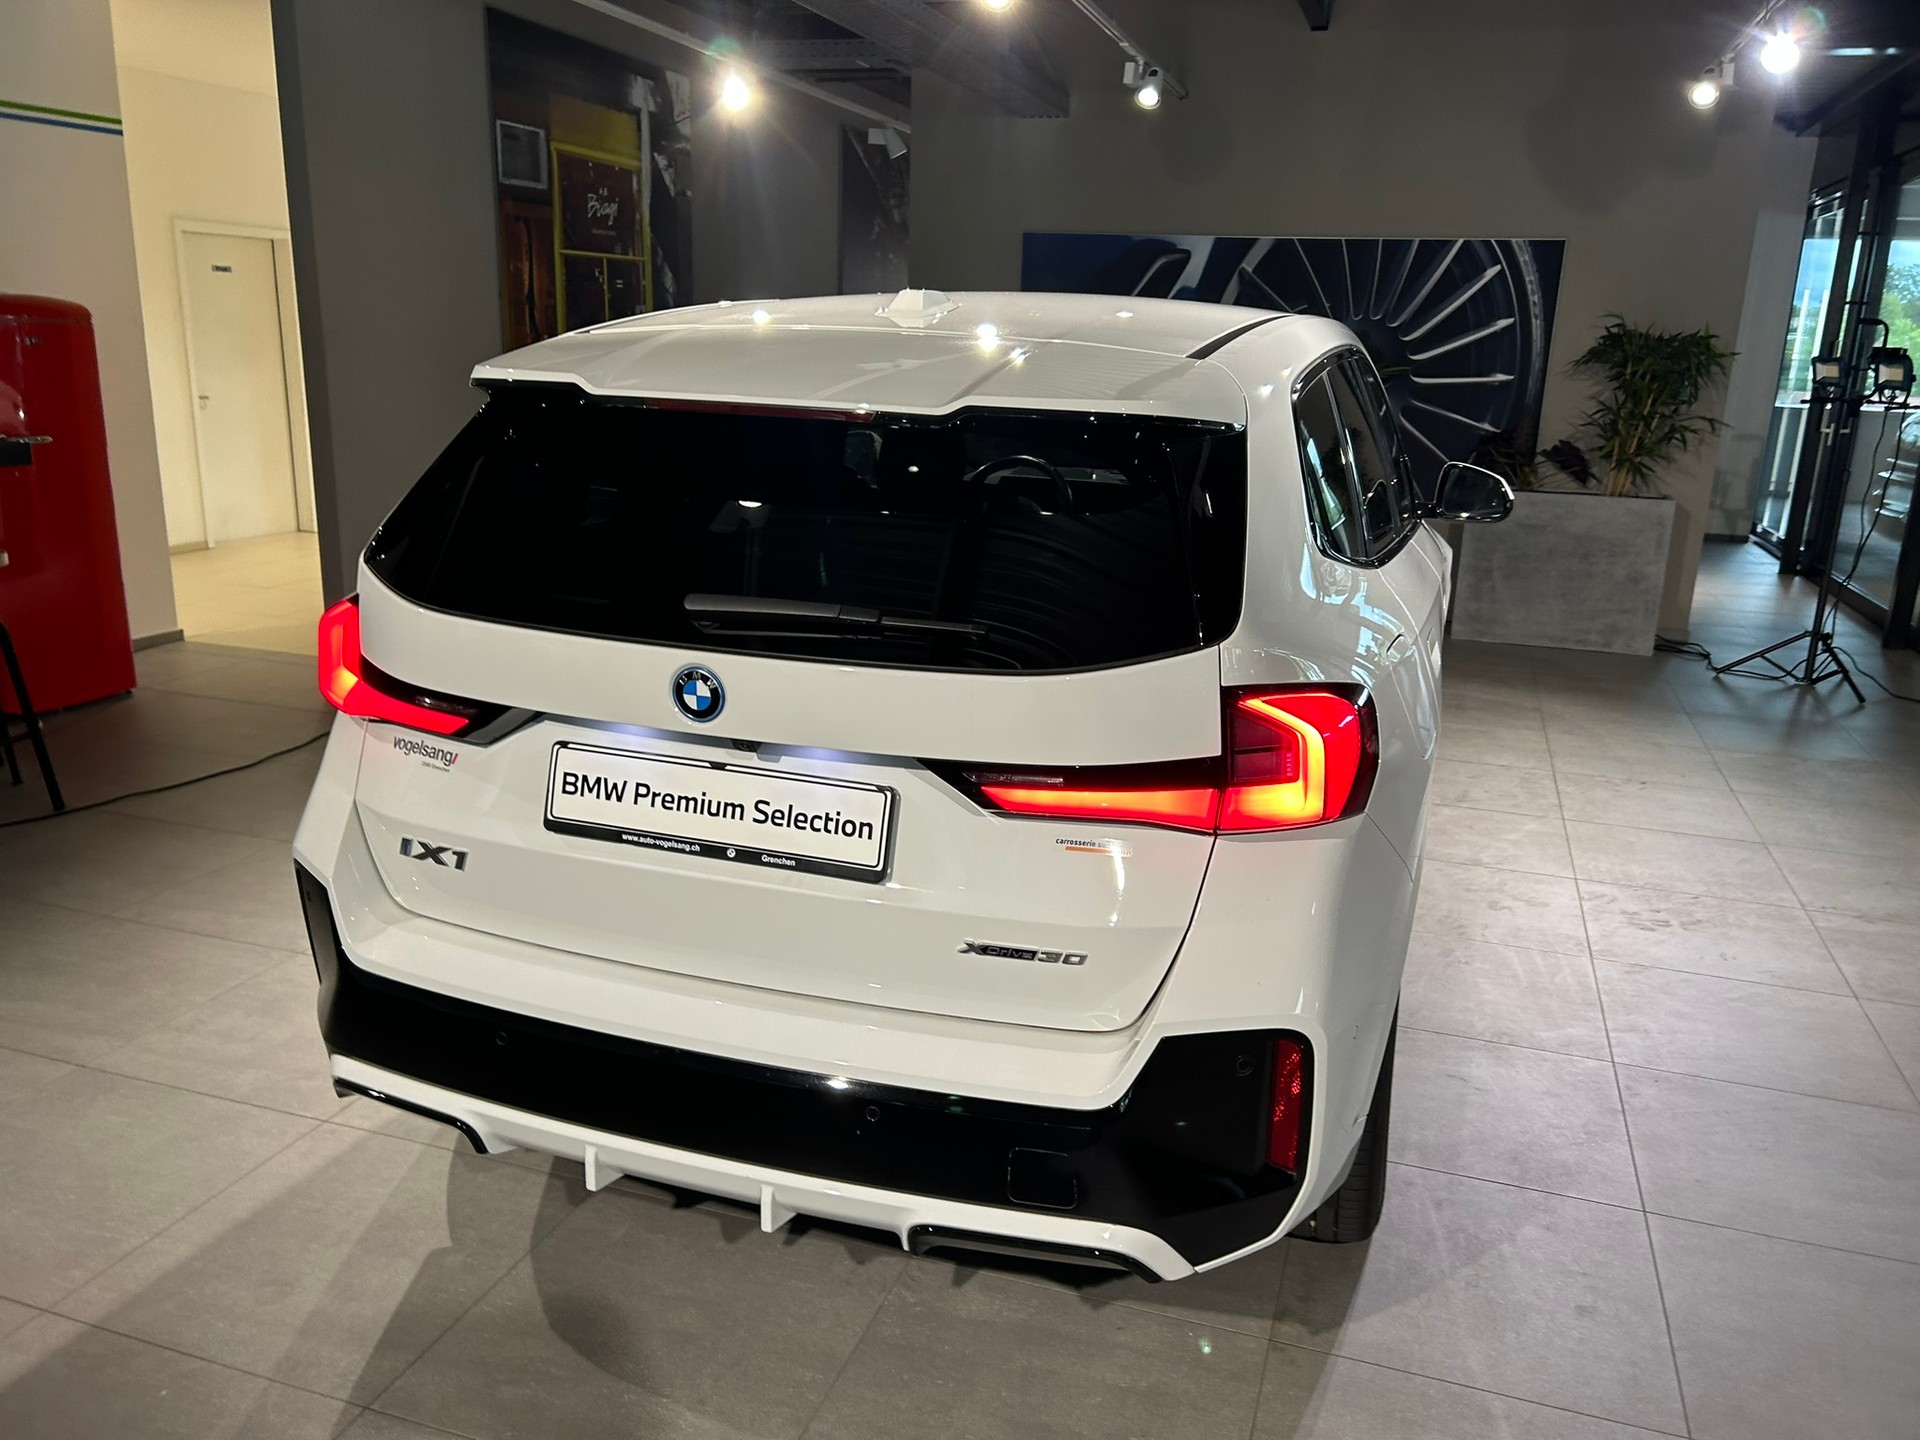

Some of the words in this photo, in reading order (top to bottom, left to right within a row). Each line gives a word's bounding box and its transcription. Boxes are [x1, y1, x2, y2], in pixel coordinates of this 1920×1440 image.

[678, 670, 717, 690] BMW
[561, 772, 627, 805] BMW
[633, 782, 747, 822] Premium
[753, 800, 876, 841] Selection
[621, 833, 701, 852] www.auto-vogelsang.ch
[761, 854, 796, 867] Grenchen
[1055, 838, 1097, 848] carrosserie
